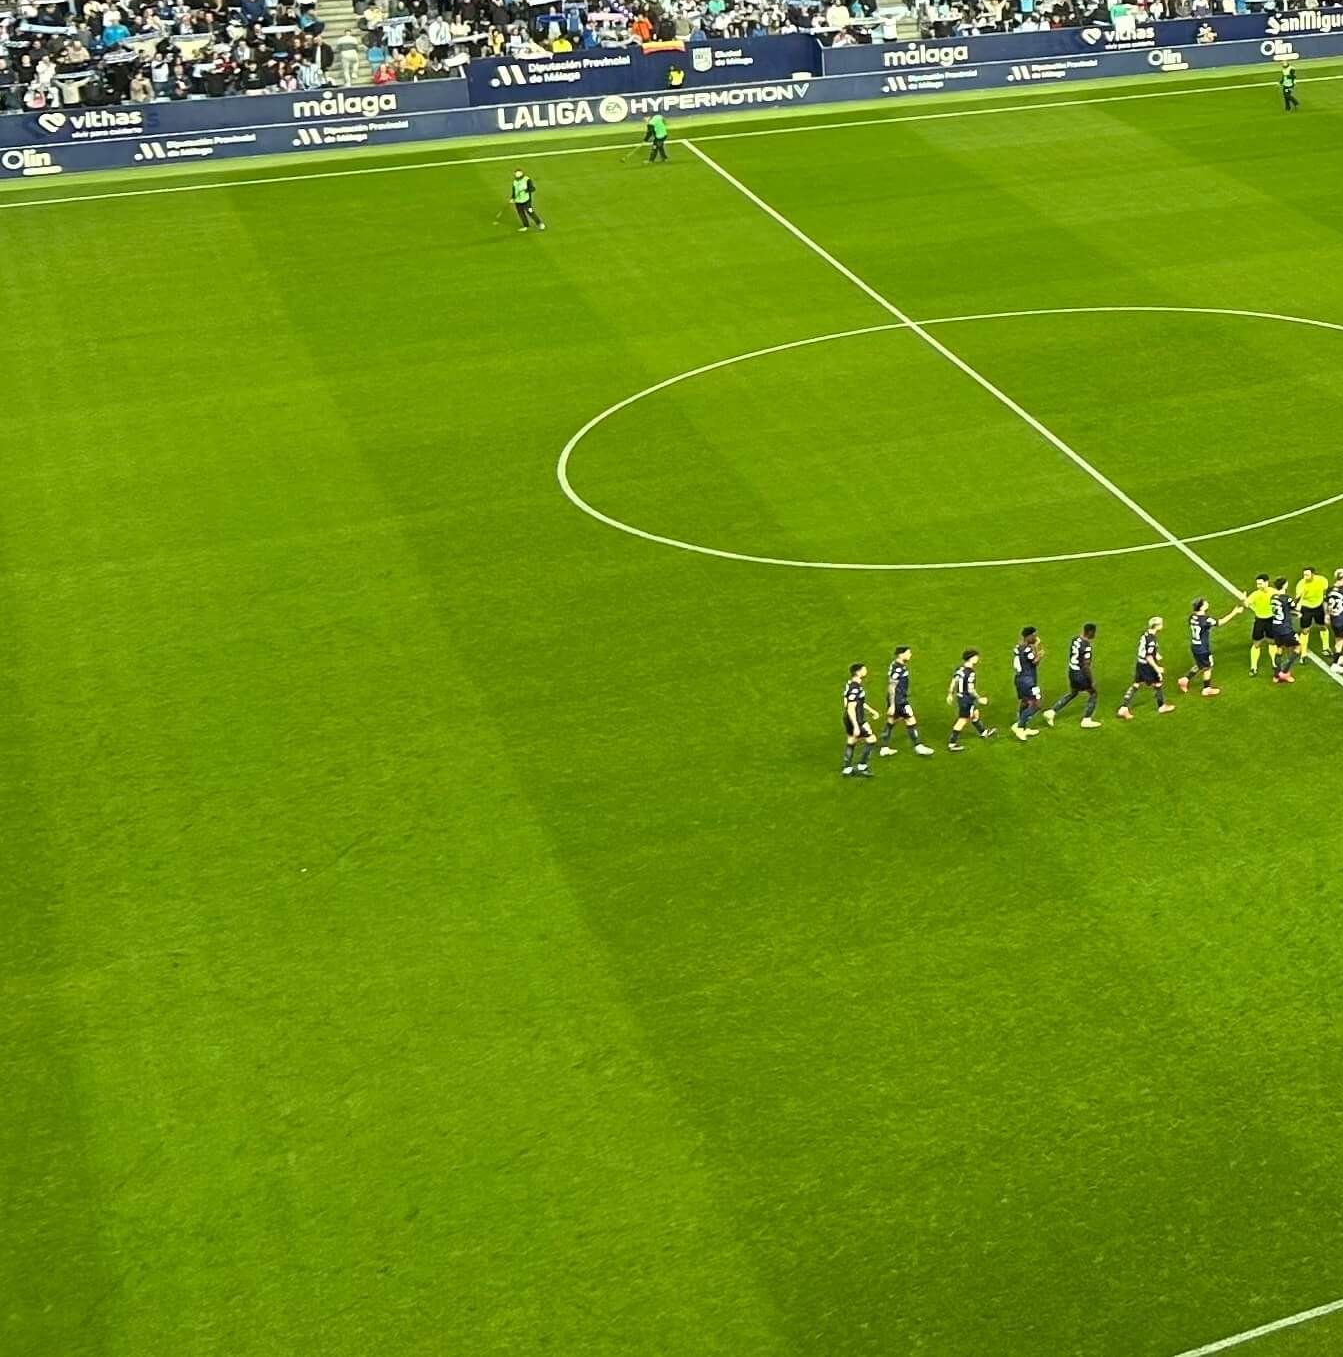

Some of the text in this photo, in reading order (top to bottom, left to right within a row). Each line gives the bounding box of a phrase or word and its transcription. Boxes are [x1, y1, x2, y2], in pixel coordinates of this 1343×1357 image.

[1105, 27, 1155, 42] vithas
[1260, 40, 1293, 56] Olin
[528, 55, 631, 74] Diputación Provincial
[1148, 50, 1182, 66] Olin
[529, 71, 581, 84] de Málaga
[70, 110, 143, 130] vithas
[497, 100, 595, 131] LALIGA
[2, 149, 52, 170] Olin
[1328, 597, 1343, 616] 23
